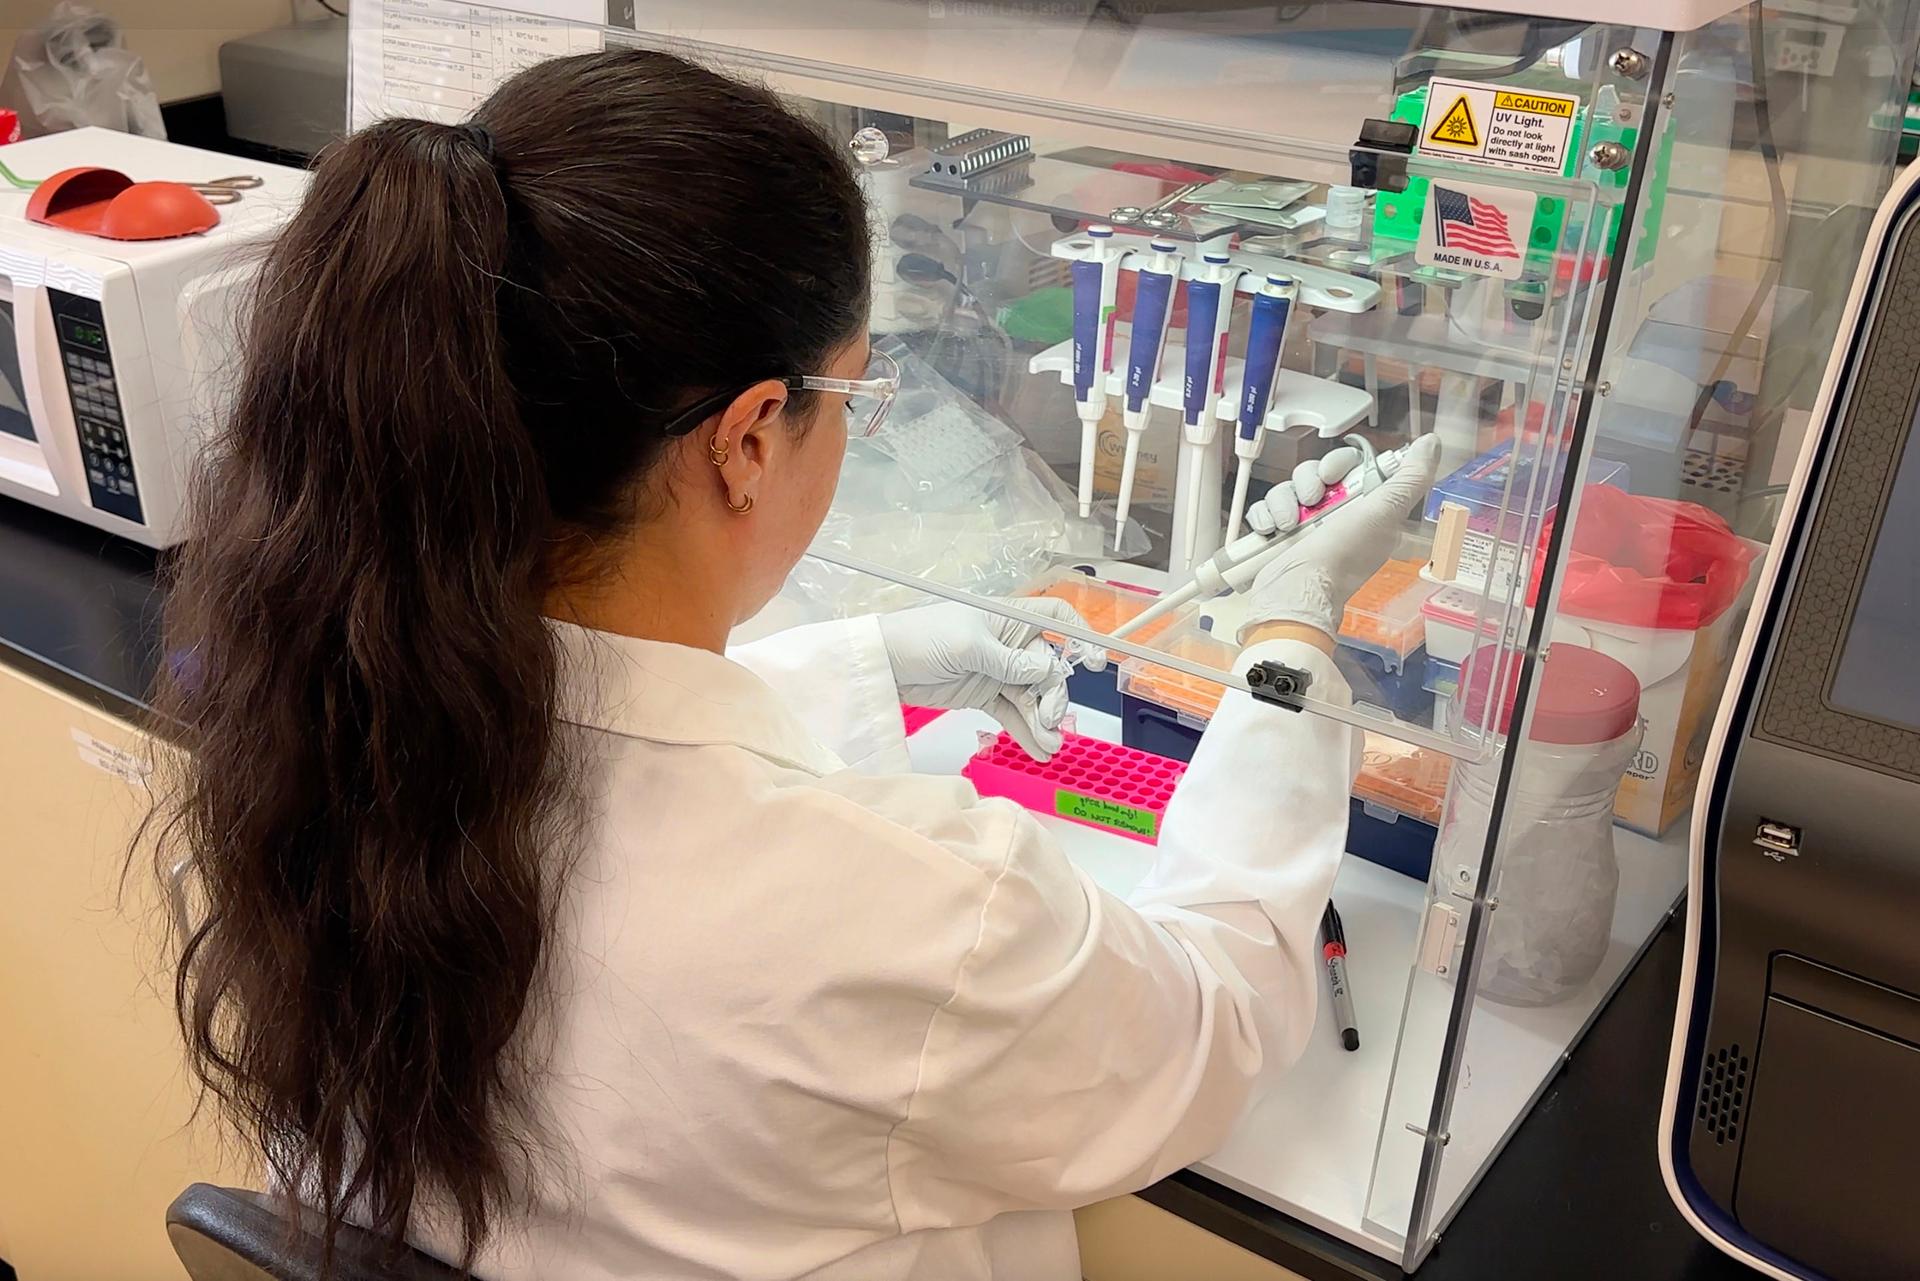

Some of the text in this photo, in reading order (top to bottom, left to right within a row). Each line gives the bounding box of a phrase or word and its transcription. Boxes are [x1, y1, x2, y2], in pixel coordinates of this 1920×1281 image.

[1514, 98, 1566, 114] CAUTION
[1496, 112, 1545, 128] UV Light.
[1493, 126, 1543, 140] Do not look
[1490, 137, 1556, 153] directly at light
[1489, 147, 1556, 163] with sash open.
[1433, 252, 1503, 272] MADE IN U.S.A.
[1073, 806, 1087, 817] DO
[1091, 814, 1112, 824] NOT
